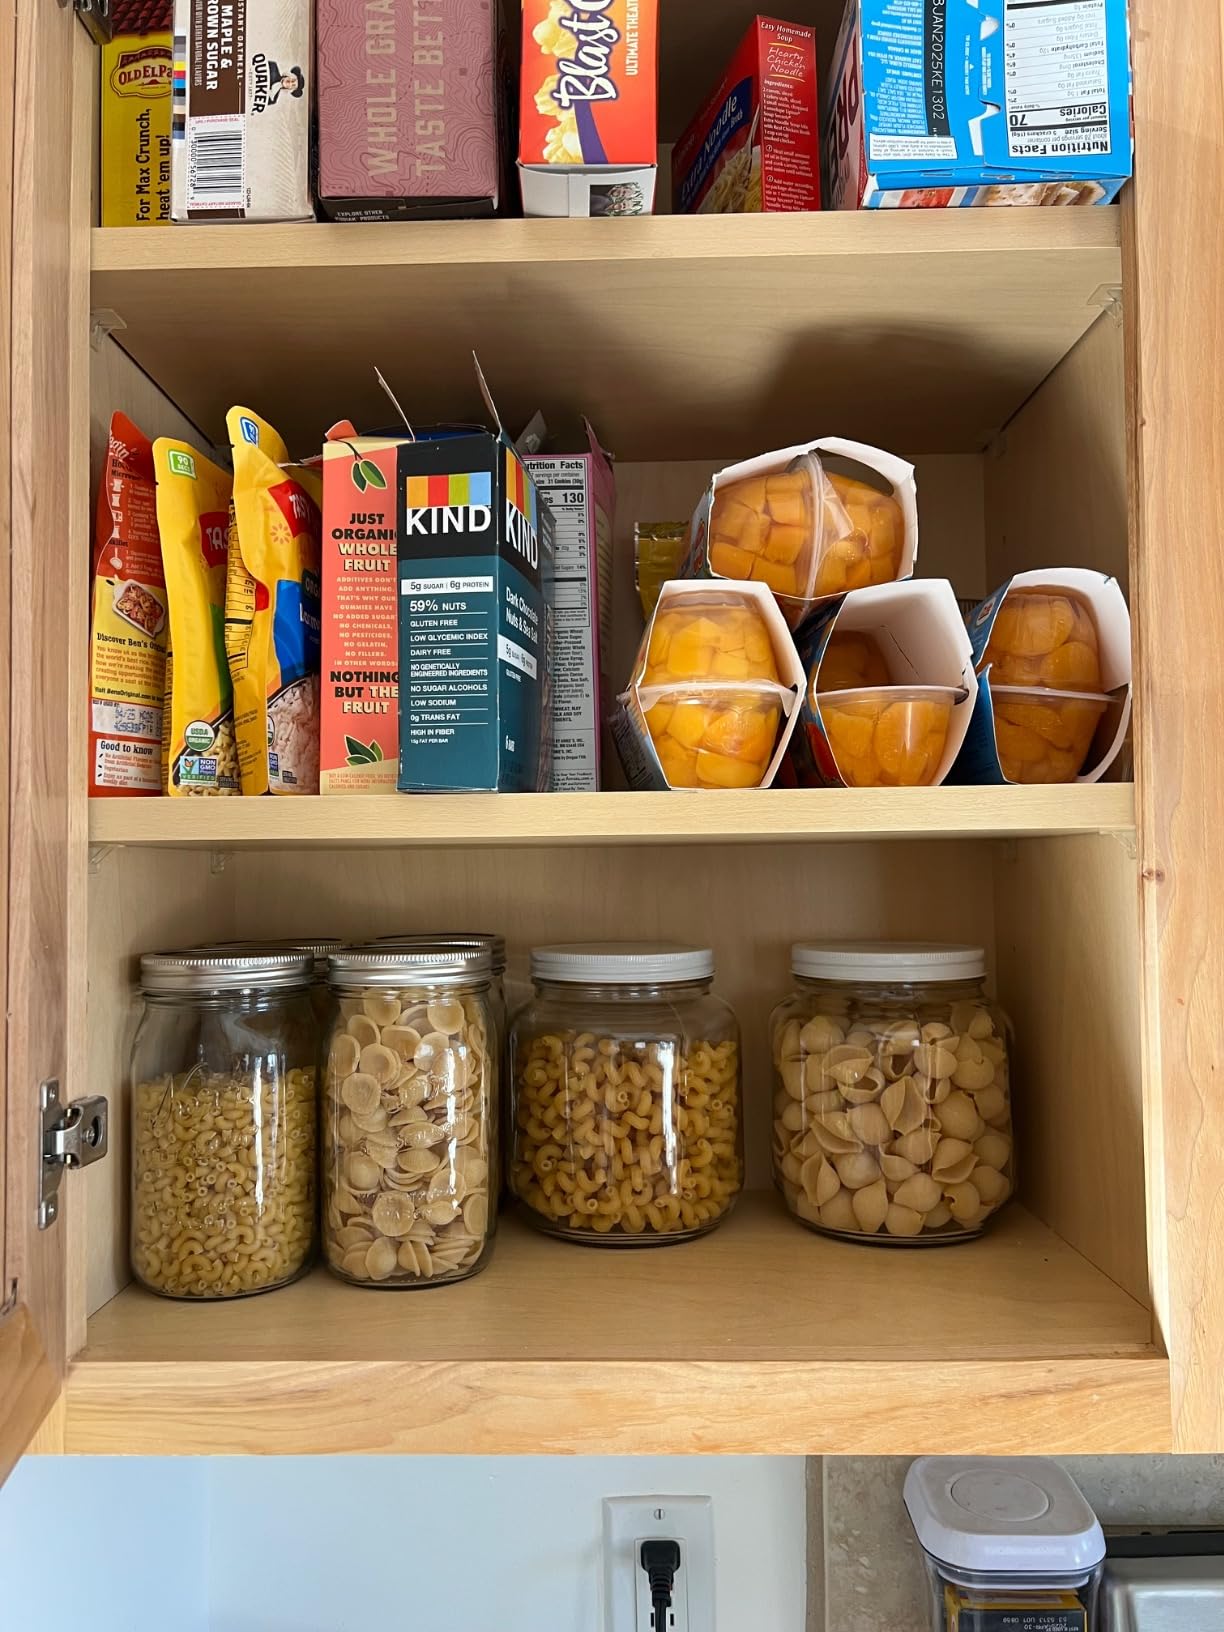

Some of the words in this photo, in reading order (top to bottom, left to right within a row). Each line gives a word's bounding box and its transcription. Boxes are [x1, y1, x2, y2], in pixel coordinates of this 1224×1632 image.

[237, 0, 246, 32] STANT
[625, 0, 639, 30] THEAT
[220, 5, 233, 52] MAPLE
[760, 21, 776, 32] Easy
[776, 24, 812, 39] Homemade
[776, 33, 794, 44] Soup
[236, 35, 244, 80] OATMEAL
[552, 13, 619, 107] Blast
[625, 31, 639, 76] ULTIMATE
[768, 47, 804, 64] Hearty
[205, 42, 219, 91] SUGAR
[220, 58, 233, 69] &
[766, 55, 806, 70] Chicken
[118, 67, 141, 85] OLD
[142, 66, 157, 79] EL
[769, 63, 804, 77] Noodle
[251, 53, 266, 113] QUAKER
[1059, 104, 1107, 117] Calories
[367, 69, 399, 177] WHOLE
[1009, 113, 1028, 127] 70
[413, 79, 447, 177] TASTE
[1080, 126, 1108, 135] Serving
[136, 108, 153, 163] Crunch,
[160, 134, 172, 160] up!
[1012, 144, 1047, 155] Facts
[1051, 141, 1108, 152] Nutrition
[136, 168, 151, 195] Max
[136, 200, 151, 221] For
[156, 189, 170, 221] heat
[177, 455, 188, 465] 90
[560, 461, 584, 469] Facts
[562, 492, 584, 503] 130
[350, 513, 385, 525] JUST
[406, 505, 492, 535] KIND
[331, 528, 397, 540] ORGANI
[506, 497, 539, 570] KIND
[338, 543, 397, 556] WHOLE
[344, 559, 391, 572] FRUIT
[410, 582, 421, 591] 5g
[450, 580, 461, 590] 6g
[506, 586, 519, 608] Dark
[410, 600, 439, 612] 59%
[442, 602, 467, 610] NUTS
[410, 619, 438, 627] GLUTEN
[506, 607, 519, 630] Nuts
[96, 632, 127, 645] Discover
[128, 638, 148, 649] Ben's
[410, 634, 427, 642] LOW
[428, 633, 464, 641] GLYCEMIC
[448, 669, 488, 677] INGREDIENTS
[334, 687, 364, 698] BUT
[369, 686, 398, 699] THE
[422, 684, 448, 692] SUGAR
[449, 683, 488, 691] ALCOHOLS
[343, 701, 390, 715] FRUIT
[410, 714, 420, 722] 0g
[190, 727, 209, 736] USDA
[101, 740, 120, 752] Good
[123, 744, 131, 753] to
[133, 744, 153, 755] know
